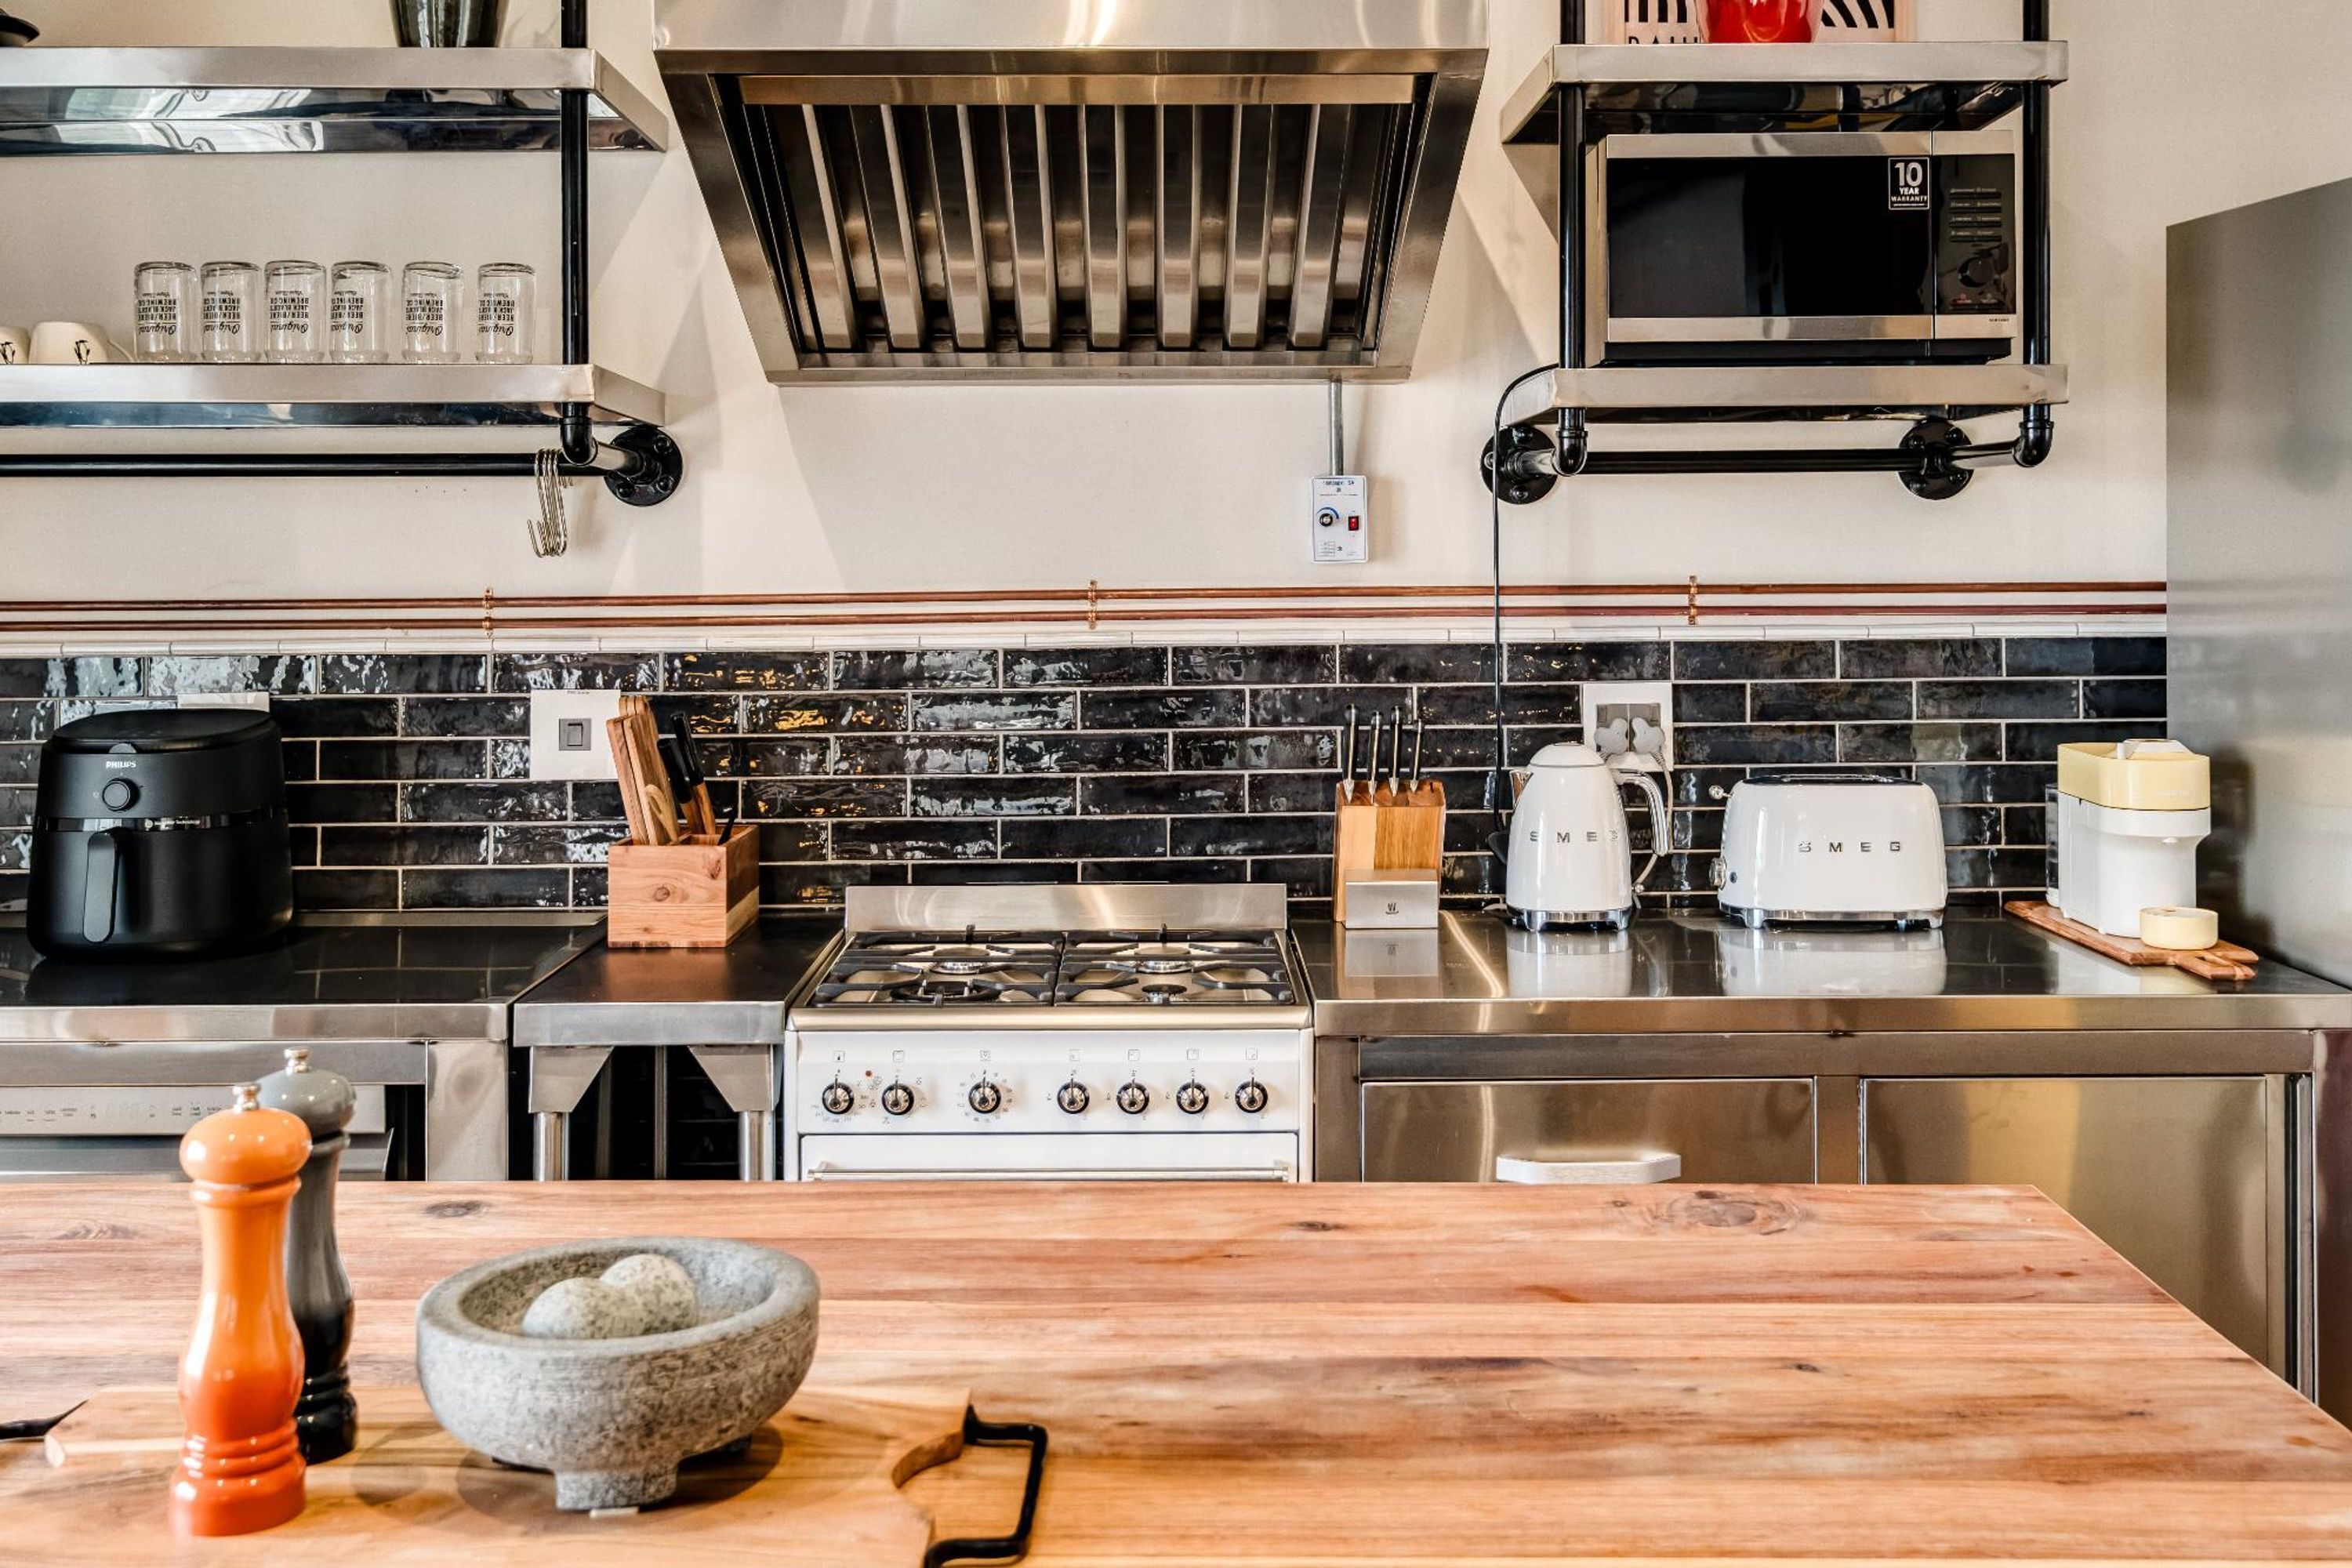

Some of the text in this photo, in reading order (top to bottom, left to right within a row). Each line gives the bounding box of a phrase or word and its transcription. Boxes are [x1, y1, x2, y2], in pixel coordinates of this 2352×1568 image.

[1894, 162, 1923, 187] 10
[270, 321, 308, 333] Original
[105, 760, 137, 769] PHILIPS
[1798, 840, 1901, 853] SMEG
